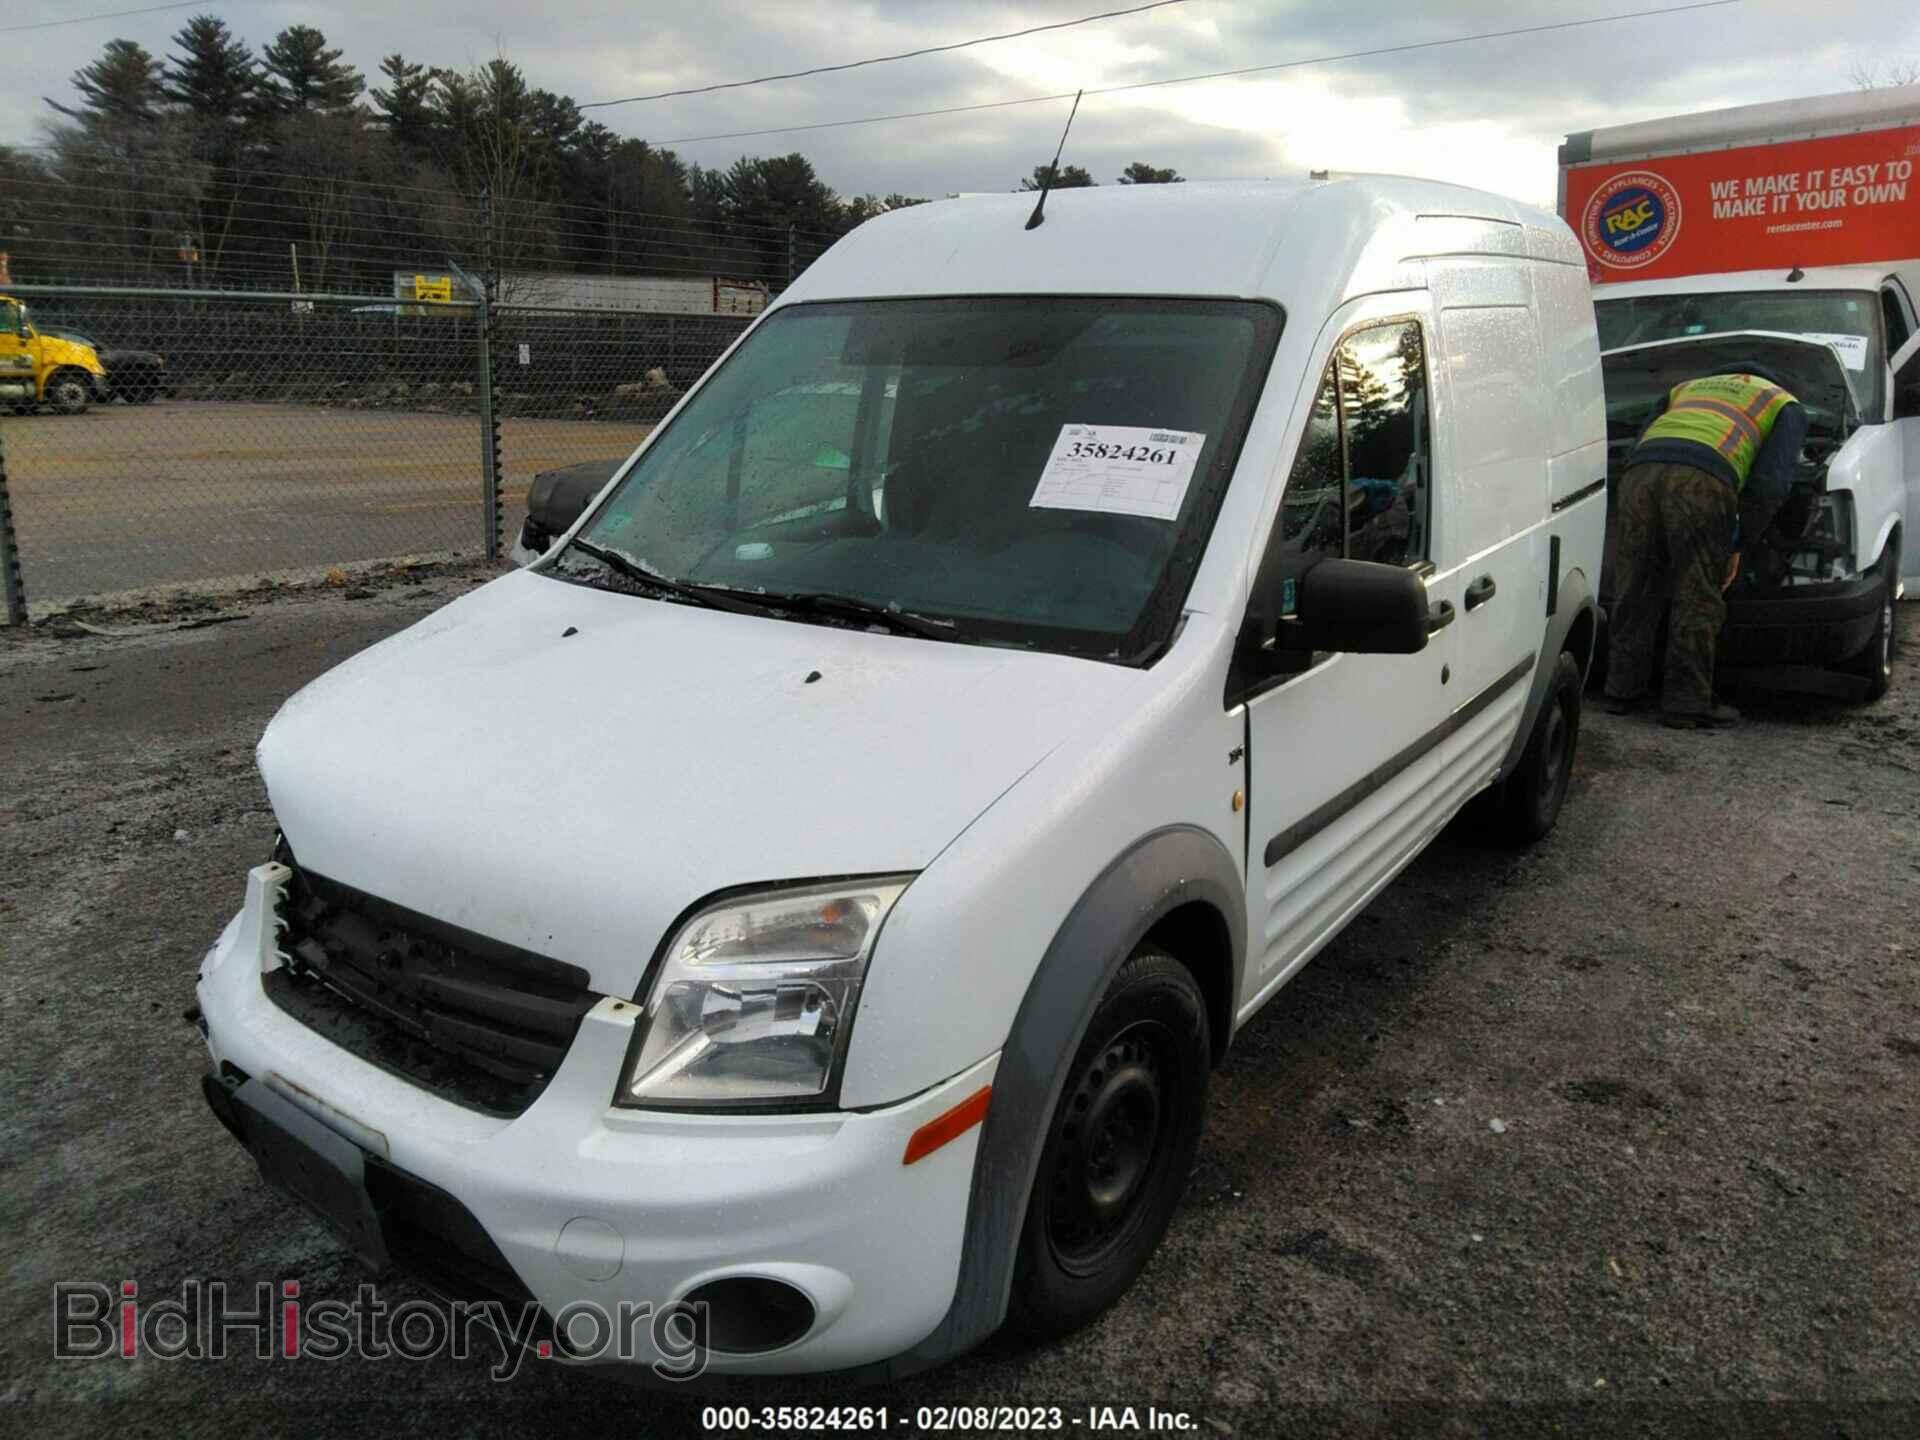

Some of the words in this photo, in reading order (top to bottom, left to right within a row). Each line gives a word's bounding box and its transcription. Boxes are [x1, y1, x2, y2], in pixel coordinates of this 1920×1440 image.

[1710, 180, 1739, 200] WE
[1745, 173, 1801, 196] MAKE
[1806, 170, 1825, 190] IT
[1830, 163, 1880, 188] EASY
[1886, 160, 1912, 181] TO
[1605, 199, 1655, 235] RAC
[1713, 196, 1766, 219] MAKE
[1772, 194, 1791, 214] IT
[1796, 188, 1846, 211] YOUR
[1853, 181, 1907, 206] OWN
[1766, 219, 1843, 235] rentacenter.com
[1066, 442, 1177, 465] 35824261
